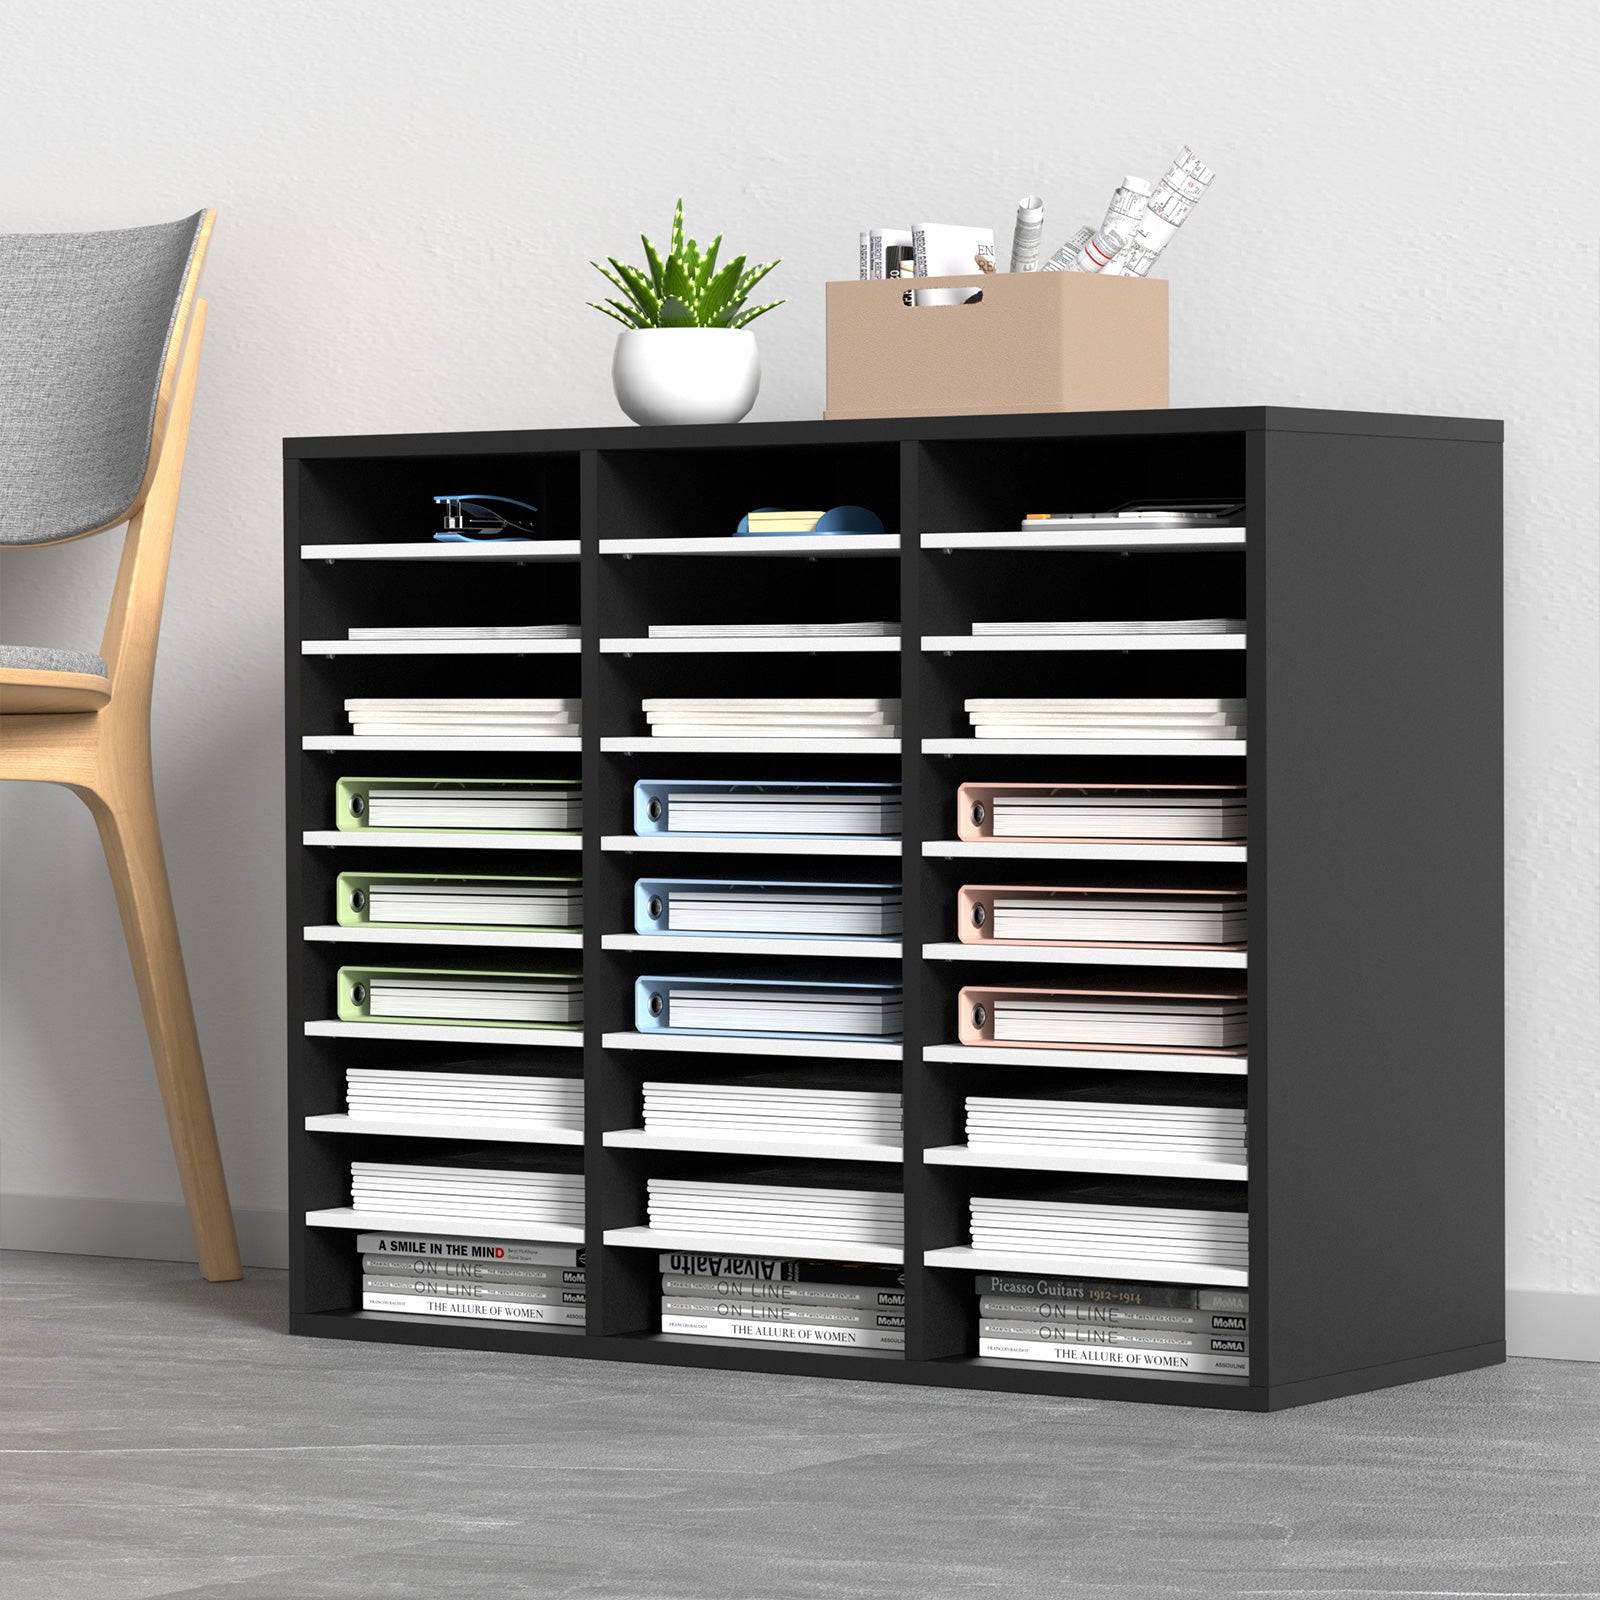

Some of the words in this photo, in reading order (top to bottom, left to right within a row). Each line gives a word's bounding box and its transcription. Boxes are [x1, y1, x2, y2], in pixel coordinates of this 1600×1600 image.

[378, 1240, 386, 1250] A
[390, 1241, 426, 1253] SMILE
[430, 1244, 442, 1254] IN
[446, 1244, 468, 1256] THE
[472, 1246, 505, 1258] MIND
[414, 1260, 438, 1274] ON
[446, 1262, 483, 1278] LINE
[564, 1272, 585, 1282] MoM
[415, 1281, 438, 1294] ON
[446, 1284, 482, 1297] LINE
[718, 1280, 742, 1296] ON
[752, 1283, 792, 1300] LINE
[991, 1277, 1034, 1294] Picasso
[1037, 1280, 1084, 1298] Guitars
[564, 1293, 586, 1302] MoM
[1212, 1296, 1244, 1309] MoMA
[427, 1301, 448, 1312] THE
[450, 1303, 488, 1315] ALLURE
[490, 1306, 502, 1316] OF
[505, 1306, 544, 1319] WOMEN
[718, 1304, 742, 1316] ON
[752, 1306, 791, 1320] LINE
[1039, 1303, 1066, 1318] ON
[1076, 1305, 1119, 1322] LINE
[1213, 1318, 1244, 1329] MoMA
[731, 1324, 752, 1335] THE
[755, 1327, 796, 1338] ALLURE
[798, 1329, 812, 1339] OF
[814, 1330, 856, 1342] WOMEN
[1040, 1326, 1066, 1340] ON
[1076, 1328, 1118, 1344] LINE
[1212, 1340, 1243, 1351] MoMA
[1054, 1348, 1078, 1360] THE
[1080, 1350, 1124, 1363] ALLURE
[1126, 1353, 1142, 1364] OF
[1144, 1354, 1189, 1368] WOMEN
